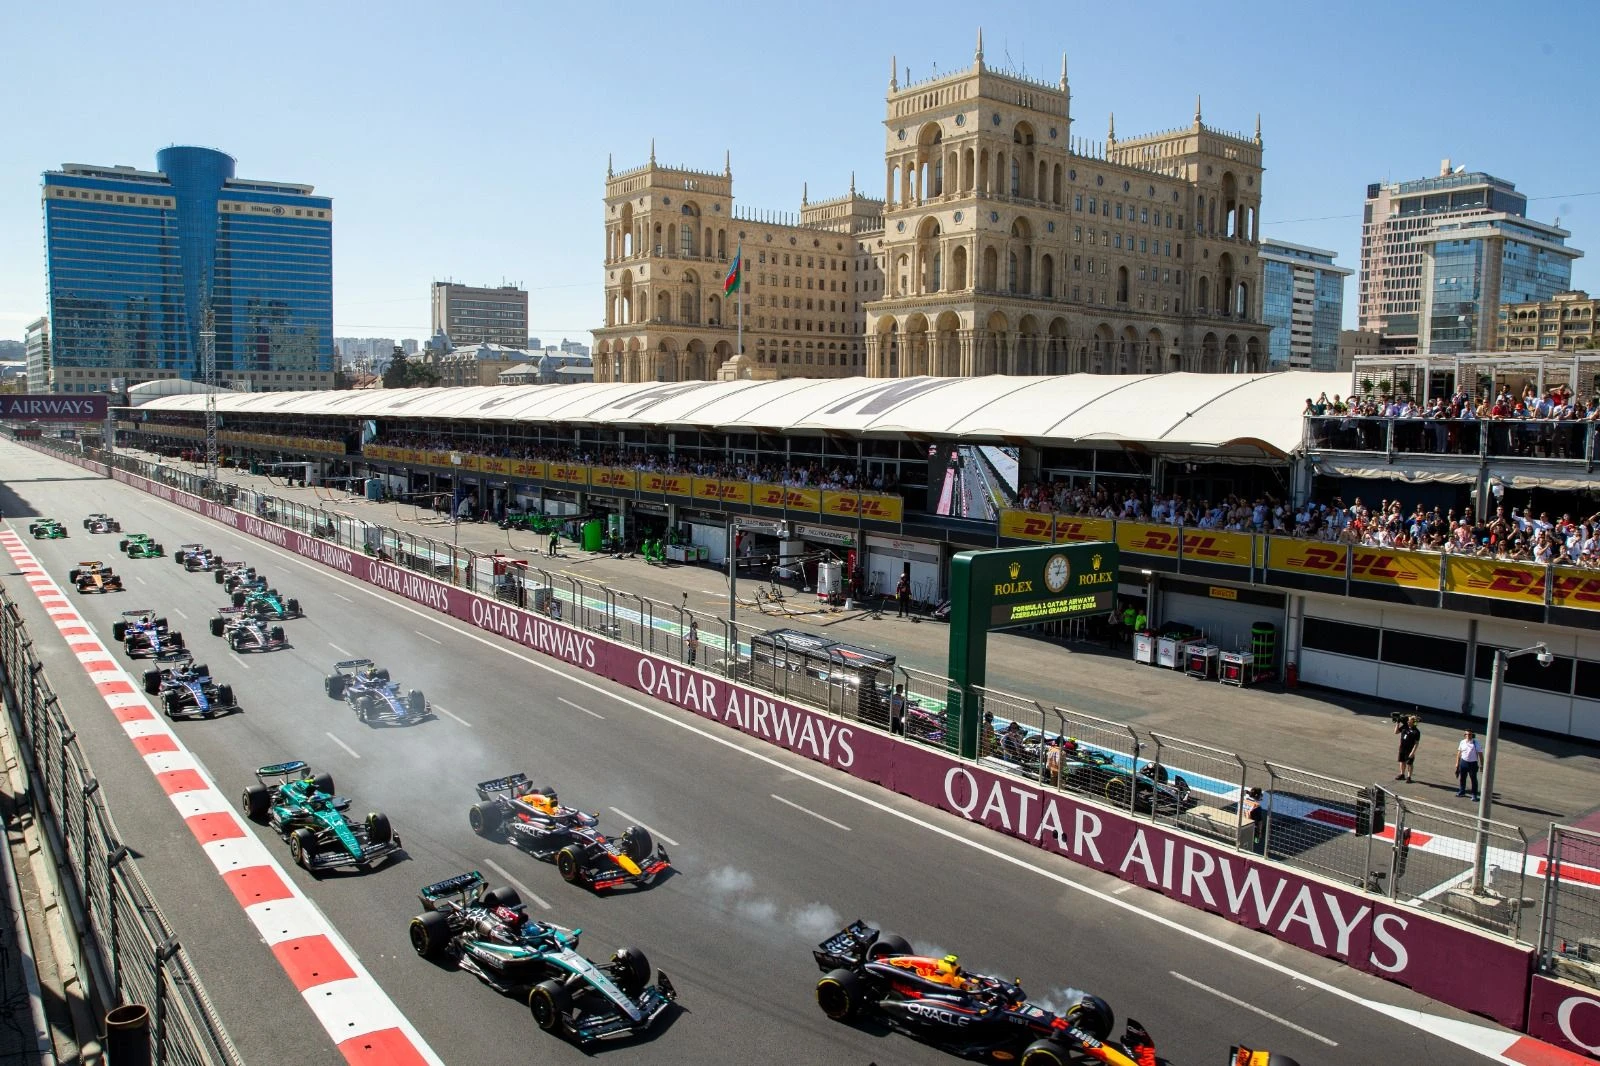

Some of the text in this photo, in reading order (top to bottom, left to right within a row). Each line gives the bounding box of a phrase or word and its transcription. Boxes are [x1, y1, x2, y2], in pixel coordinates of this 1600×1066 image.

[251, 205, 271, 213] Hilton
[9, 400, 94, 414] AIRWAYS
[517, 465, 537, 476] DHL
[556, 468, 578, 480] DHL
[600, 472, 625, 485] DHL
[651, 478, 679, 492] DHL
[705, 483, 736, 499] DHL
[767, 490, 805, 507] DHL
[838, 497, 883, 516] DHL
[245, 516, 287, 546] QATAR AIRWAYS
[1022, 518, 1087, 541] DHL
[1143, 531, 1220, 557] DHL
[297, 535, 352, 572] QATAR AIRWAYS
[1302, 549, 1399, 578] DHL
[369, 561, 448, 610] QATAR AIRWAYS
[1079, 571, 1113, 585] ROLEX
[994, 580, 1033, 596] ROLEX
[1010, 602, 1097, 620] AZERBAIJAN GRAND PRIX 2024
[1012, 603, 1042, 613] FORMULA
[1048, 599, 1068, 608] QATAR
[1068, 596, 1095, 605] AIRWAYS
[472, 598, 595, 668] QATAR AIRWAYS
[637, 658, 854, 767] QATAR AIRWAYS
[514, 822, 545, 838] ORACLE
[944, 767, 1409, 973] QATAR AIRWAYS
[429, 873, 472, 892] PETRONAS
[907, 1002, 971, 1028] ORACLE
